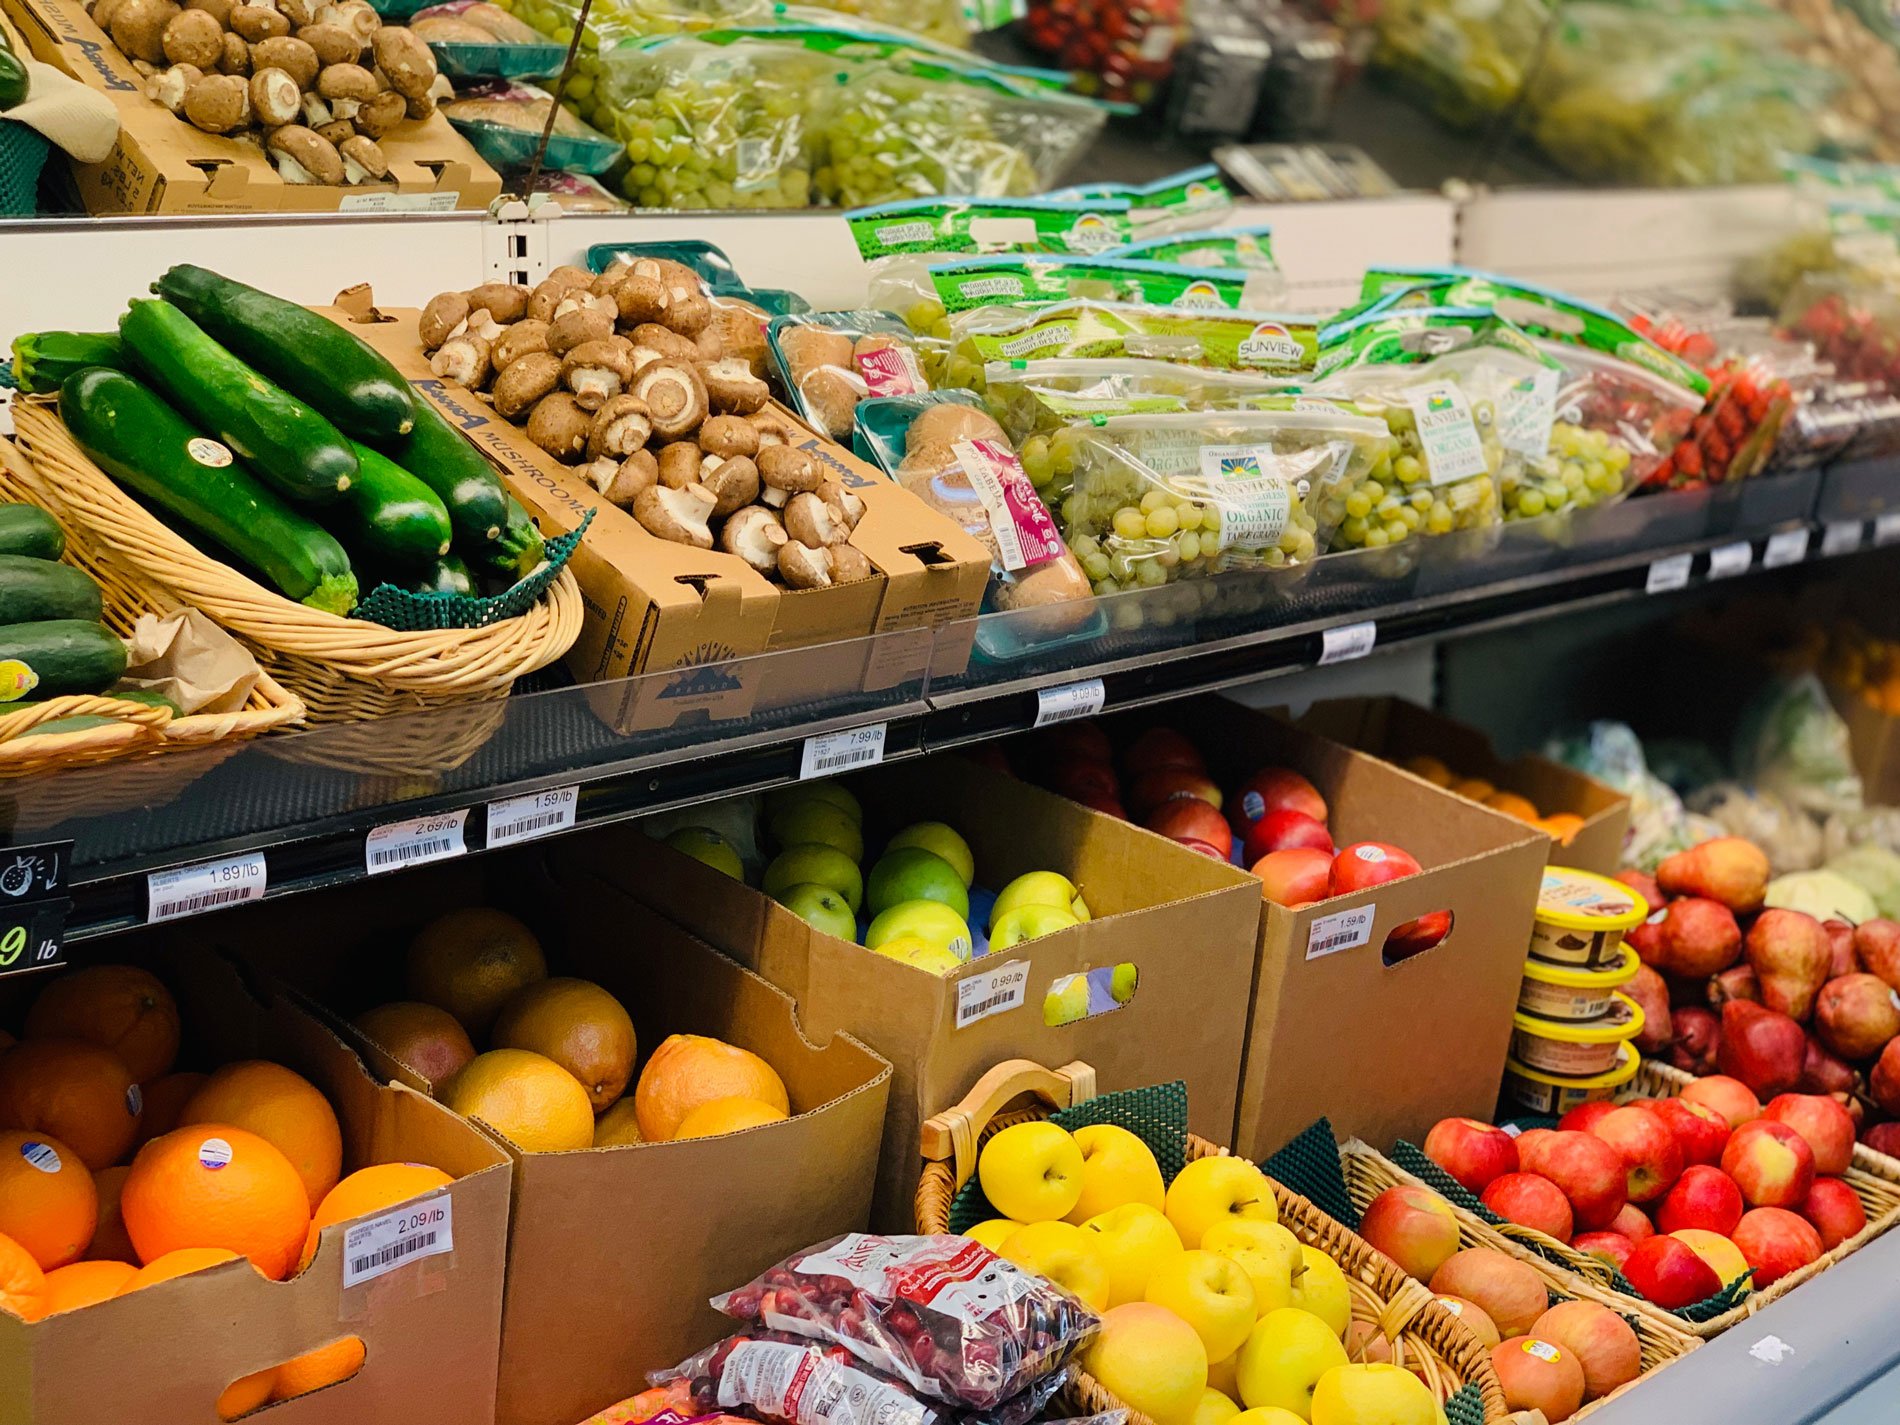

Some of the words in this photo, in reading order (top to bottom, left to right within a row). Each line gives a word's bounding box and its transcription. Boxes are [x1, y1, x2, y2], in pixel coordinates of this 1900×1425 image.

[1240, 341, 1302, 358] SUNVIEW
[478, 431, 592, 518] MUSHROOMS
[1226, 508, 1284, 523] ORGANIC
[675, 682, 728, 696] PROUD
[850, 730, 883, 745] 7.99/lb
[534, 791, 573, 808] 1.59/lb
[415, 819, 458, 835] 2.69/lb
[210, 863, 259, 883] 1.89/lb
[1340, 914, 1366, 928] 1.59/lb
[37, 939, 57, 960] lb
[992, 972, 1023, 989] 0.99/lb
[399, 1209, 445, 1234] 2.09/lb
